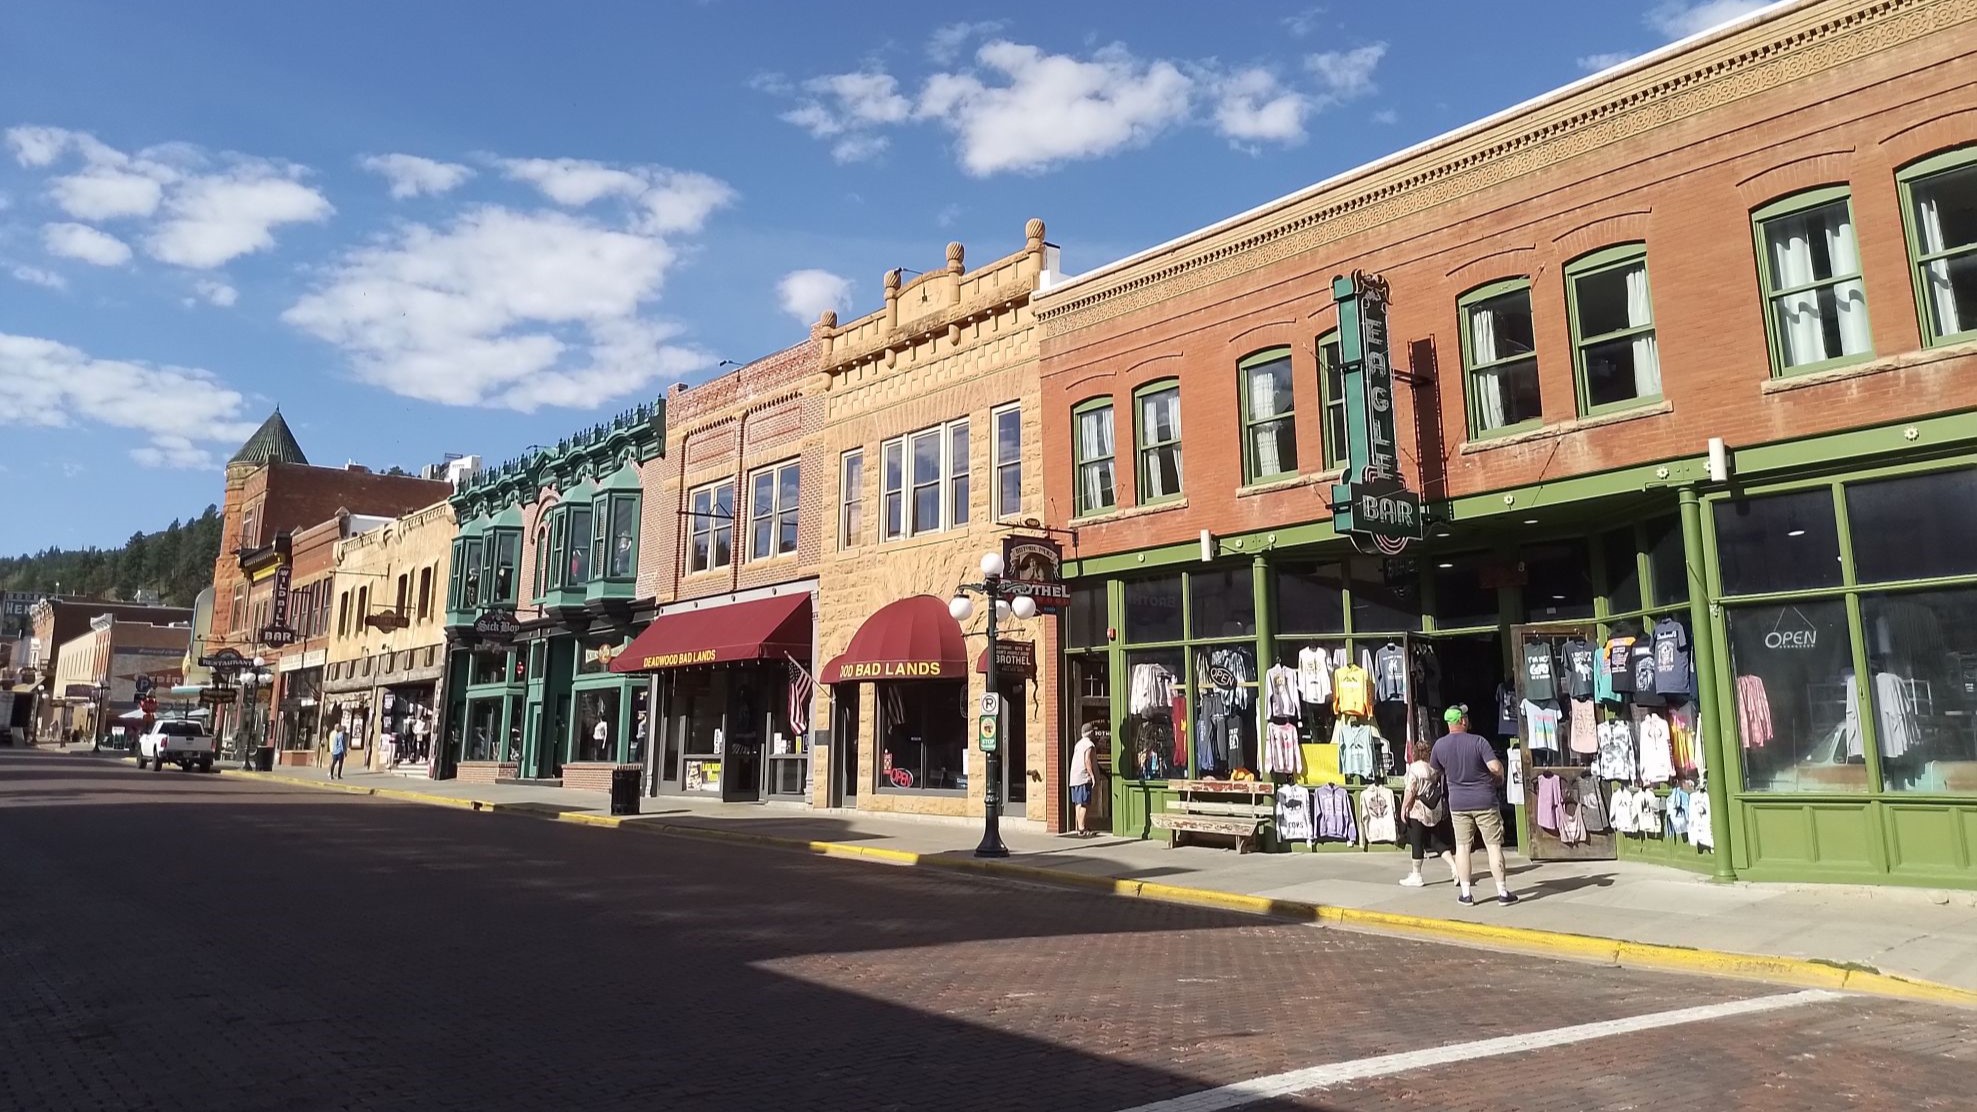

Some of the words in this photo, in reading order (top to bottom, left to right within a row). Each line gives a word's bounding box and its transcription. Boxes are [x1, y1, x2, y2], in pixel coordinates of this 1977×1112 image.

[1365, 318, 1392, 481] EAGLE
[1362, 495, 1414, 527] BAR
[278, 569, 289, 597] WILD
[275, 600, 286, 627] BILL
[264, 631, 292, 641] BAR
[476, 620, 499, 632] Sick
[500, 621, 520, 635] Boy
[1765, 630, 1817, 648] OPEN
[203, 659, 253, 668] RESTAURANT
[643, 654, 678, 668] DEADWOOD
[679, 652, 693, 664] BAD
[693, 649, 716, 662] LANDS
[855, 663, 881, 676] BAD
[885, 662, 941, 676] LANDS
[1210, 667, 1235, 687] OPEN
[891, 769, 913, 788] OPEN
